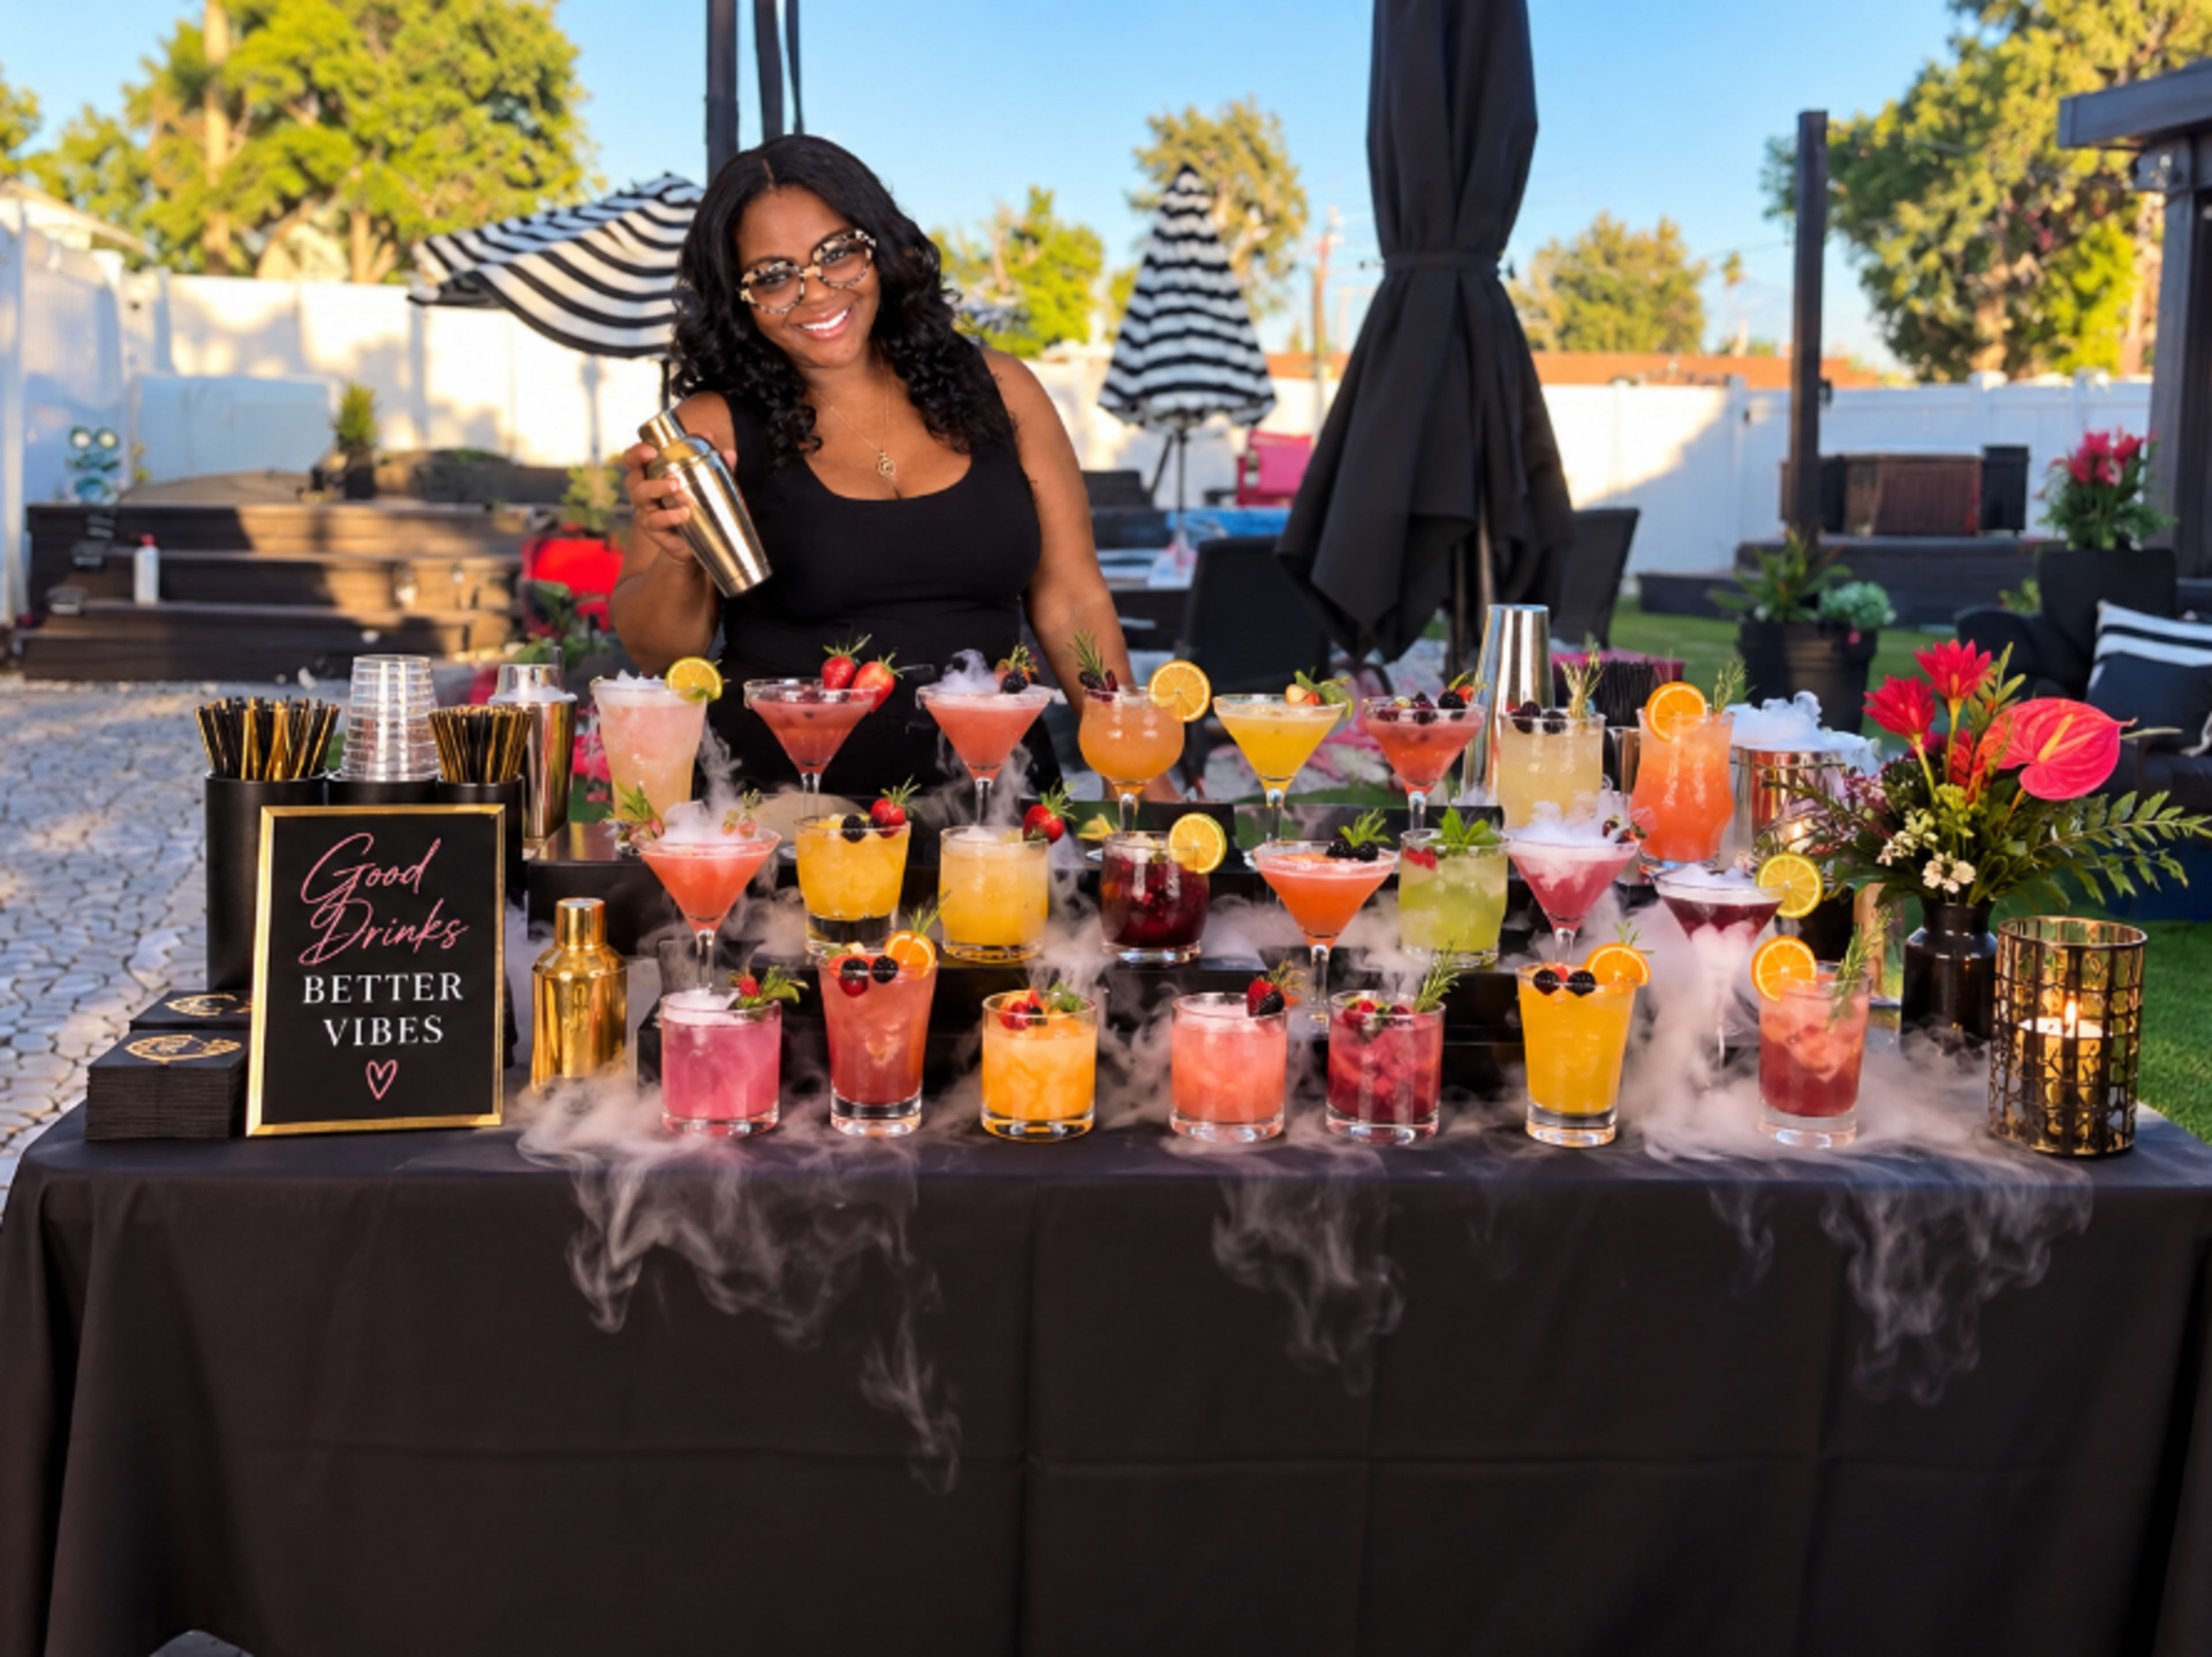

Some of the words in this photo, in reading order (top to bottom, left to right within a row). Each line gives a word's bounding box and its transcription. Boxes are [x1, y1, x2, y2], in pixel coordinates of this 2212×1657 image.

[300, 832, 441, 929] Good
[298, 897, 469, 966] Drinks
[303, 972, 463, 1004] BETTER
[323, 1014, 443, 1046] VIBES
